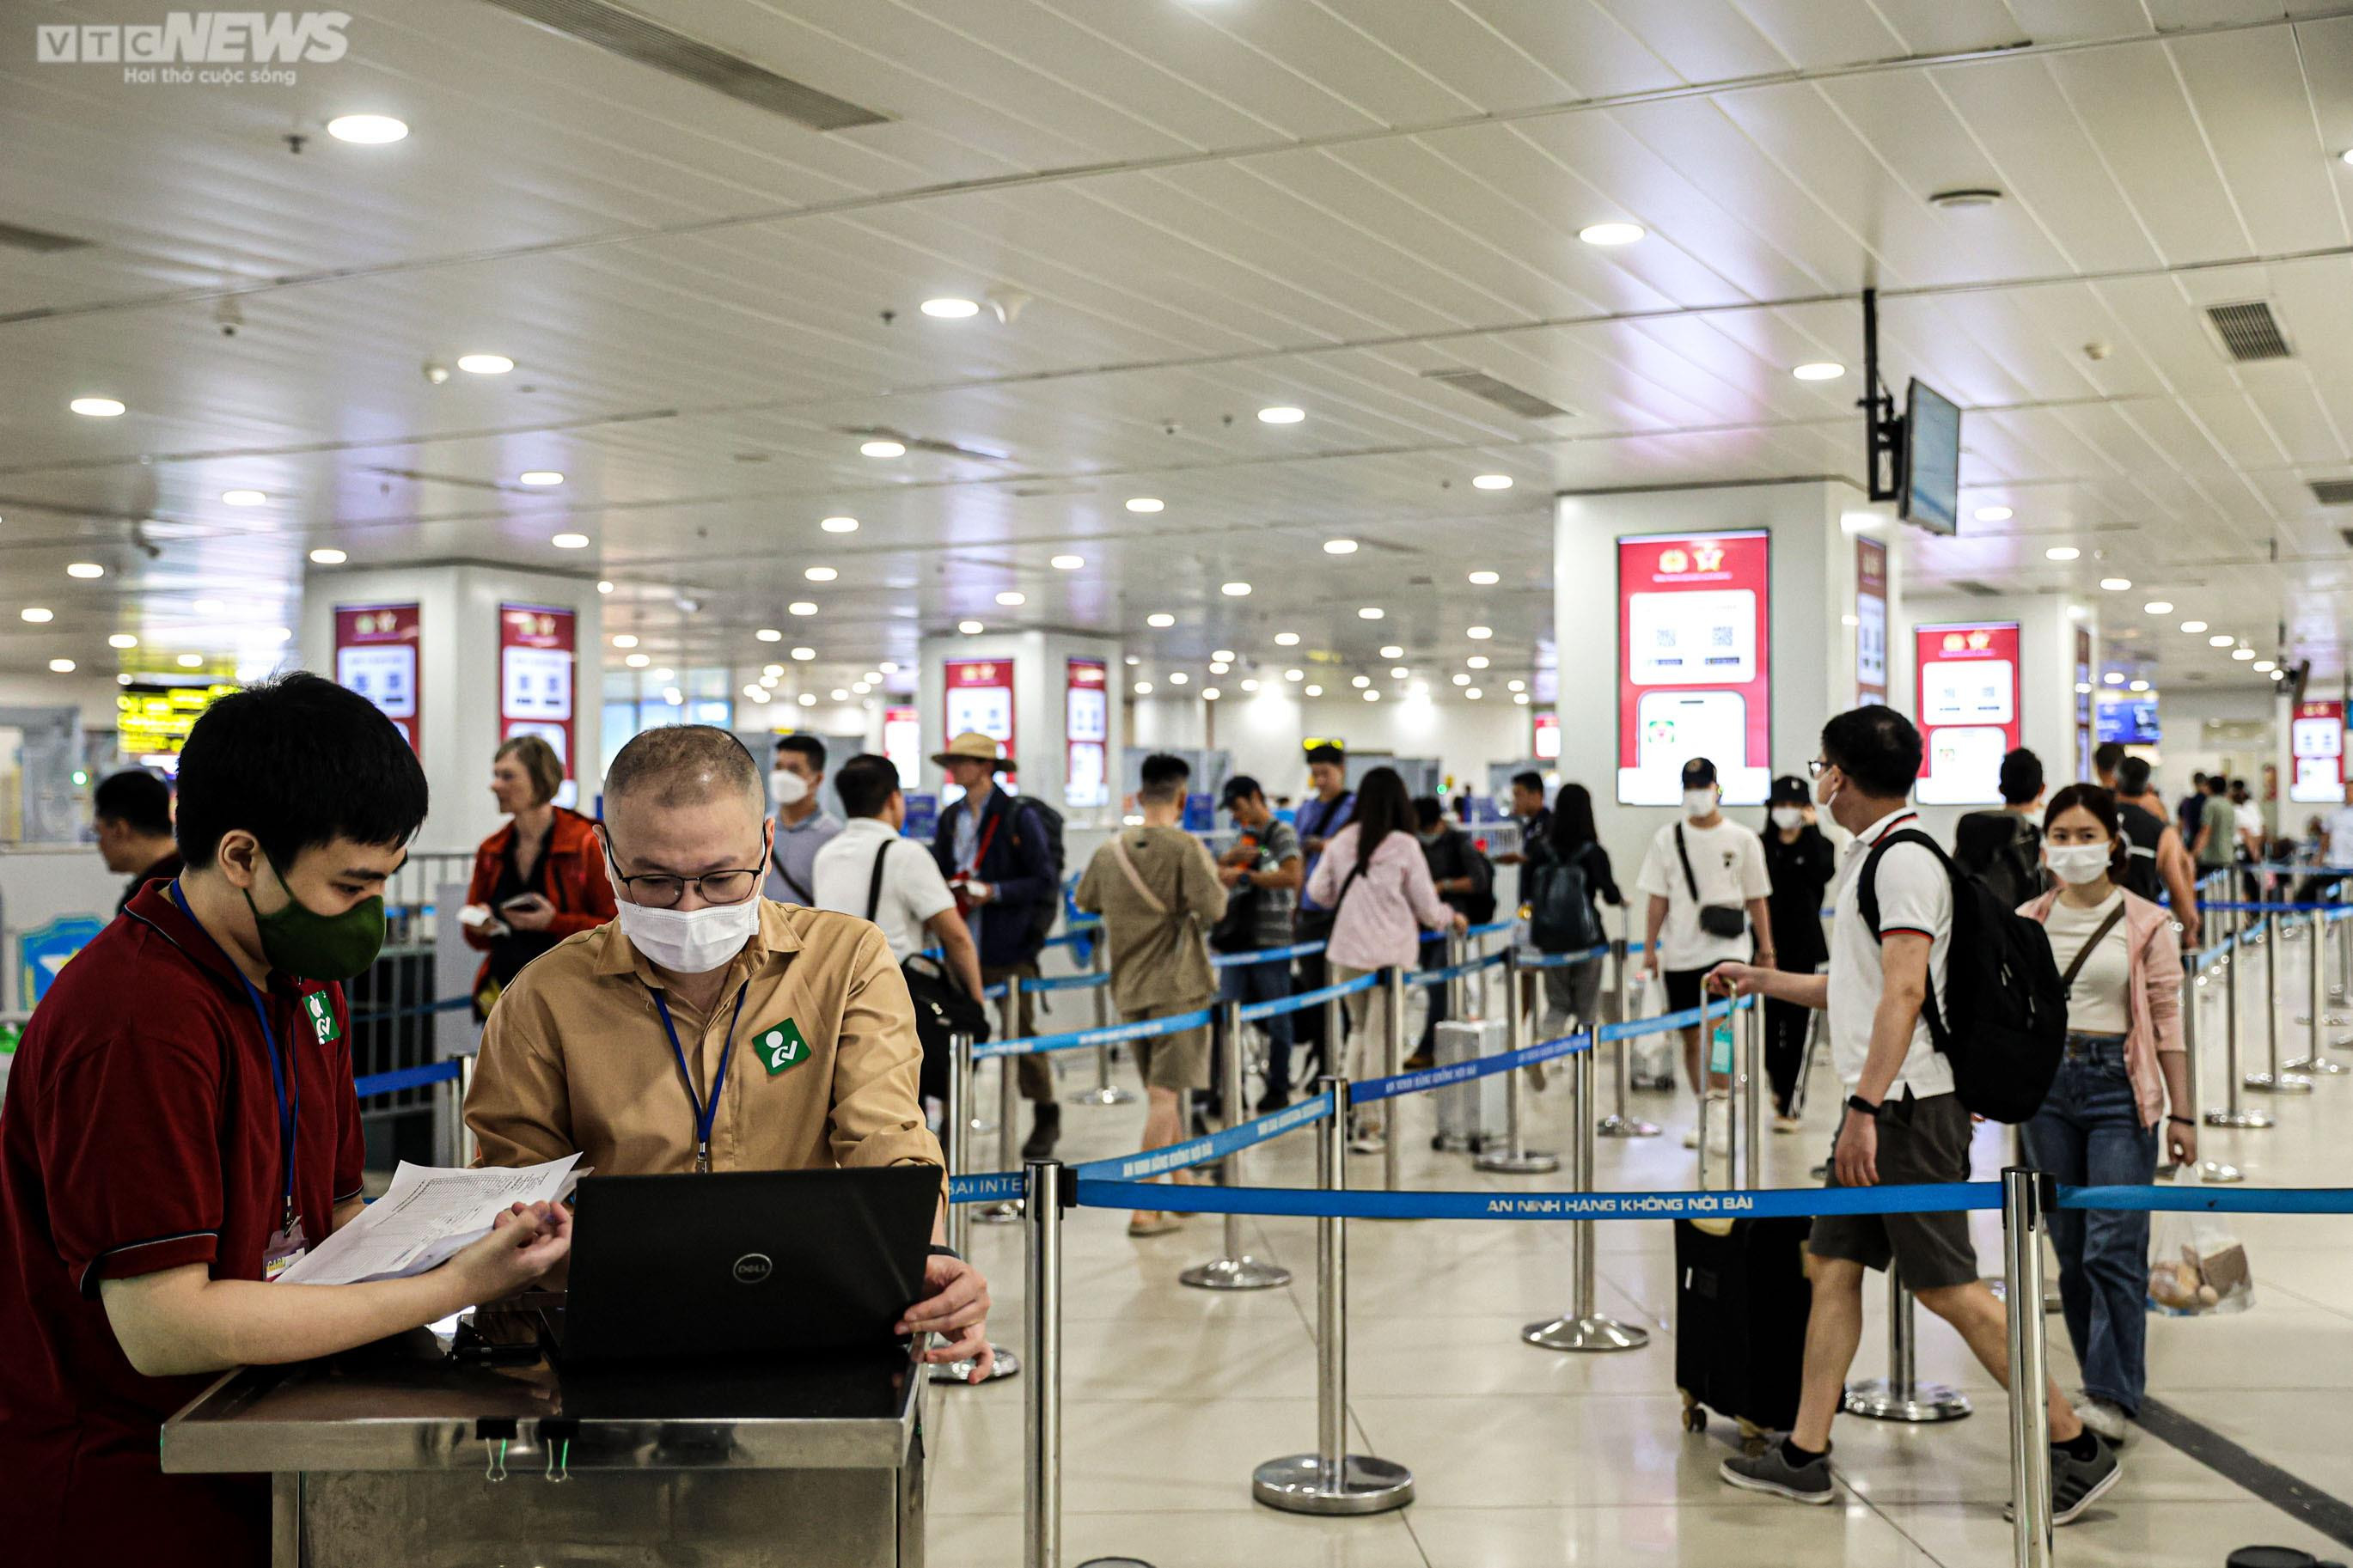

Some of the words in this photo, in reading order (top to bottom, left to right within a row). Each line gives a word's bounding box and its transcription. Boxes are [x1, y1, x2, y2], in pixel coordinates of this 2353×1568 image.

[1487, 1199, 1513, 1212] AN
[1517, 1199, 1561, 1212] NINH
[1620, 1195, 1684, 1211] KHÔNG
[1688, 1194, 1719, 1212] NỘI
